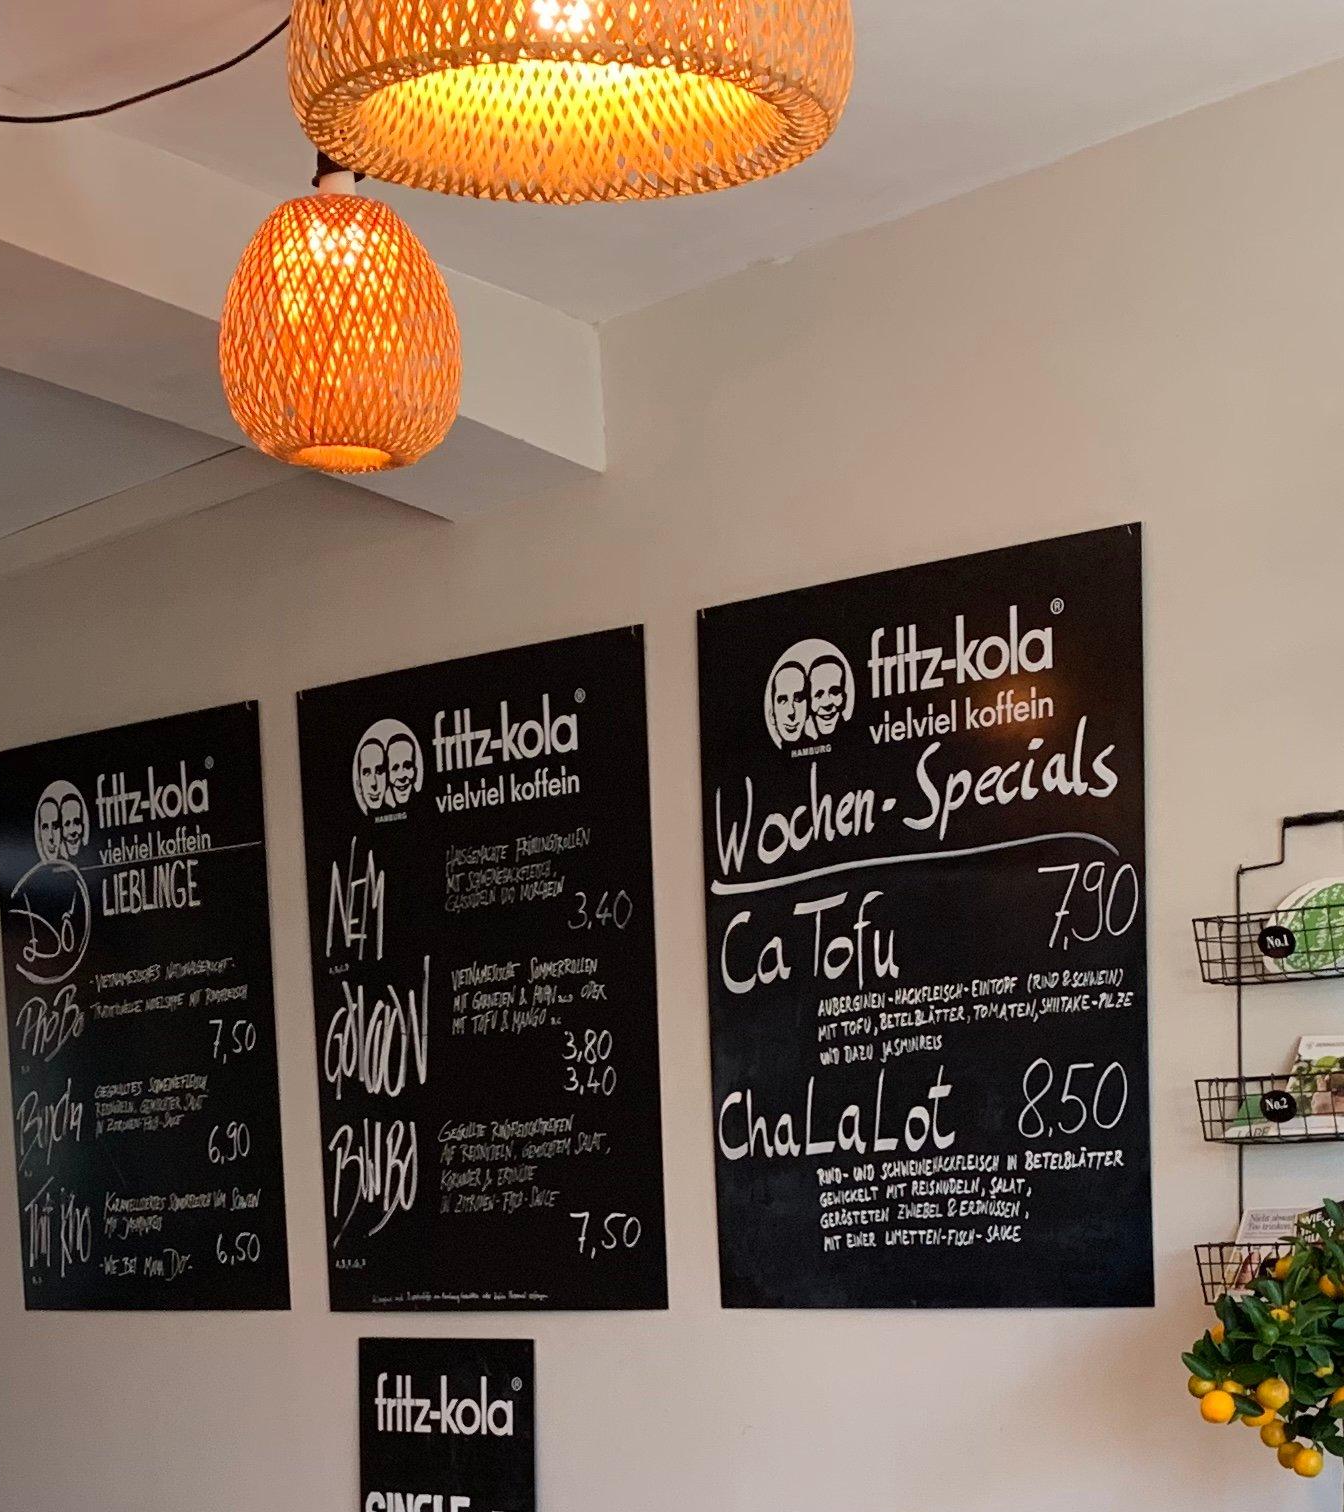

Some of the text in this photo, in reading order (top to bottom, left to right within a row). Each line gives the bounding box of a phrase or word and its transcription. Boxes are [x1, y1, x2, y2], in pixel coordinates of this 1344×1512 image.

[868, 605, 1053, 699] fritz-kola
[432, 693, 579, 773] fritz-kola
[869, 686, 1054, 744] vielviel koffein
[790, 743, 832, 759] HAMBURG
[96, 760, 209, 830] fritz-kola
[435, 765, 580, 814] vielviel koffein
[99, 825, 212, 866] vielviel koffein
[102, 859, 202, 918] LIEBLINGE
[793, 890, 900, 990] Tofu
[818, 1023, 838, 1043] MIT
[844, 1043, 874, 1064] DAZU
[852, 1162, 876, 1182] UND
[1024, 1146, 1126, 1172] BETELBLÄTTER
[819, 1185, 880, 1208] GEWICKELT
[885, 1182, 908, 1200] MIT
[897, 1201, 944, 1221] ZWIEBEL
[824, 1234, 843, 1252] MIT
[846, 1230, 878, 1249] EINER
[374, 1372, 514, 1437] fritz-kola
